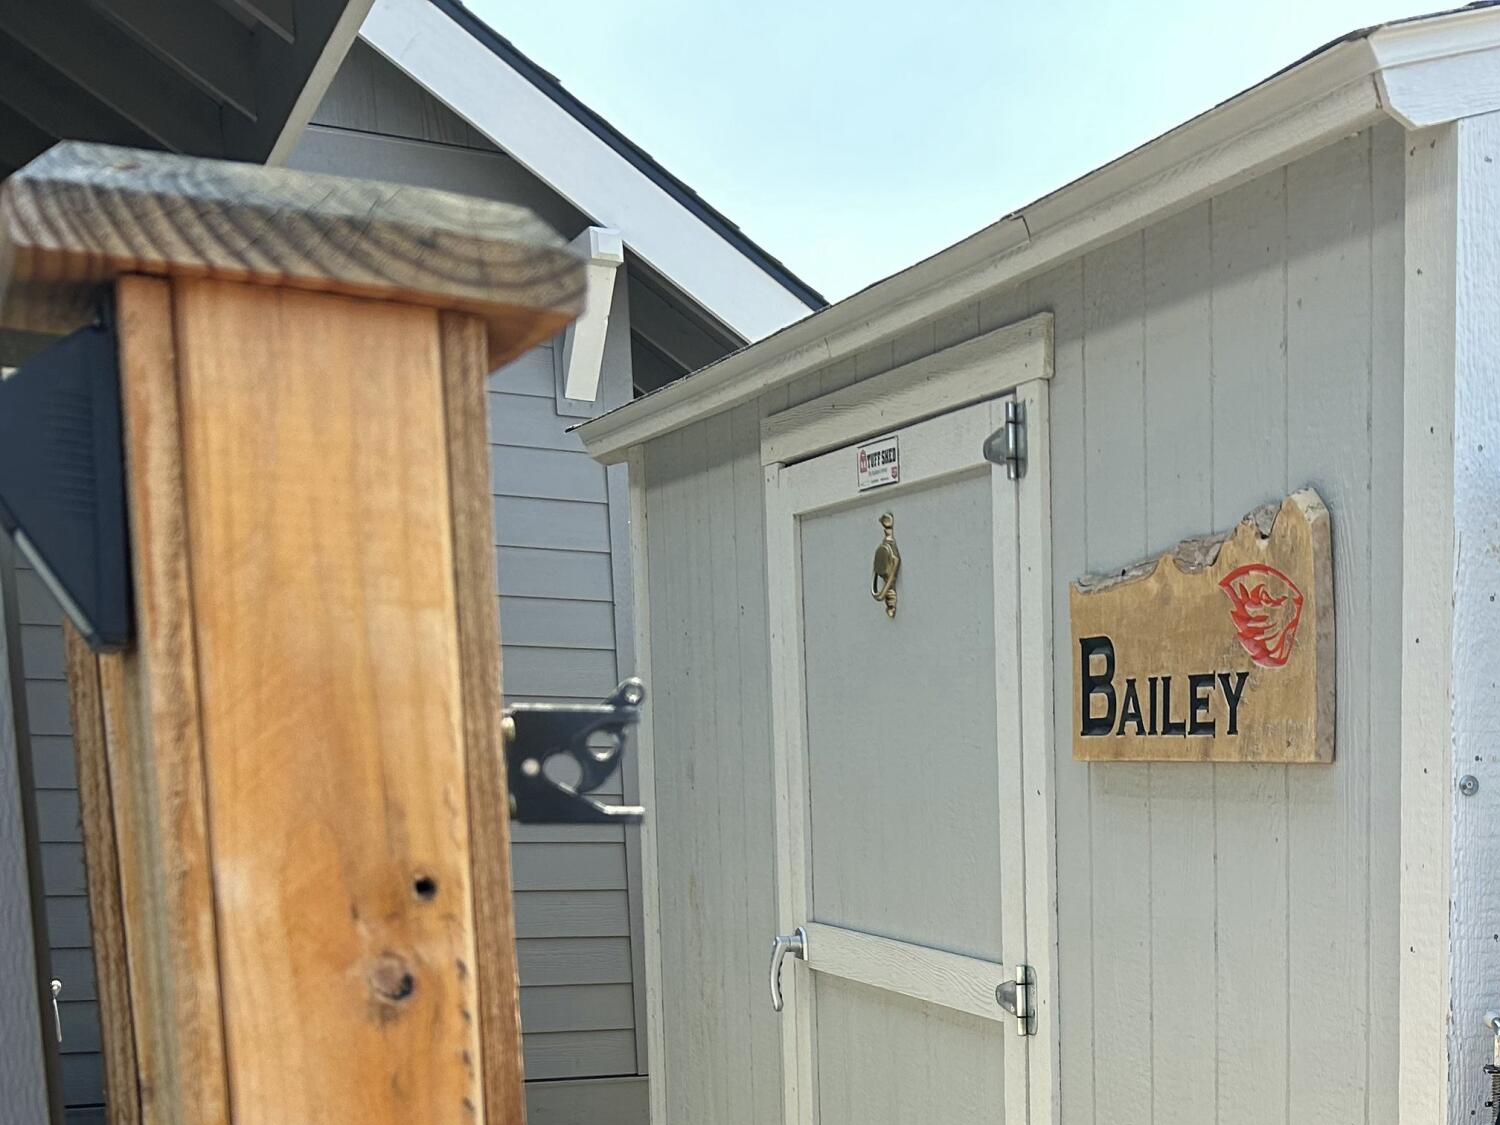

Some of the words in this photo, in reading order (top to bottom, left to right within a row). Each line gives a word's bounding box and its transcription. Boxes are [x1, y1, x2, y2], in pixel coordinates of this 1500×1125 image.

[867, 451, 880, 469] TUFF
[881, 447, 896, 465] SHED
[1079, 635, 1249, 739] BAILEY
